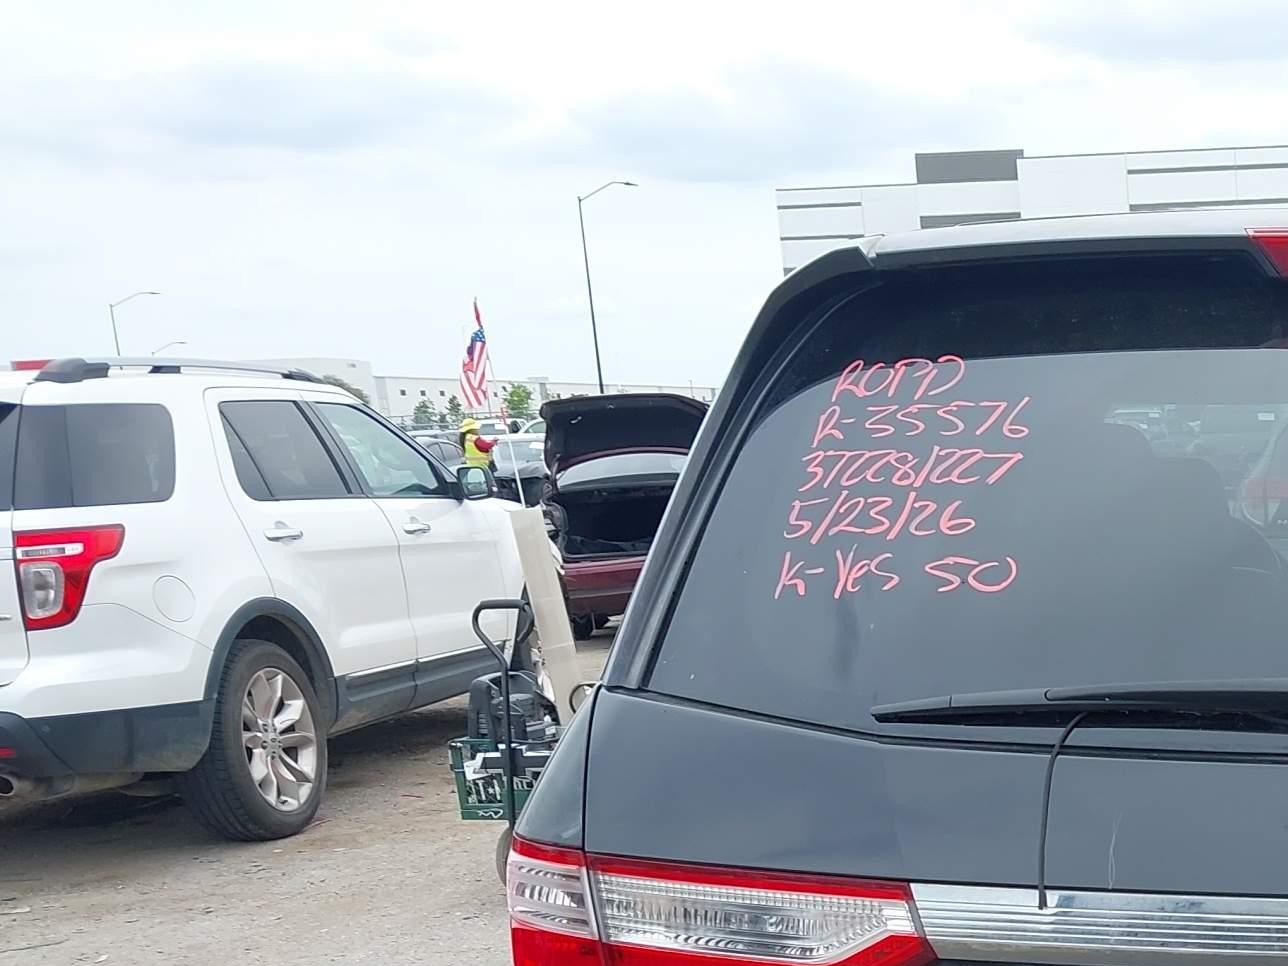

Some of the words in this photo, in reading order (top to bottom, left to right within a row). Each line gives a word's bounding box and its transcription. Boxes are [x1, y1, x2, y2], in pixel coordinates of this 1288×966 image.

[811, 396, 1031, 448] R-35576
[783, 490, 976, 545] 5/23/26
[924, 556, 1018, 592] 50
